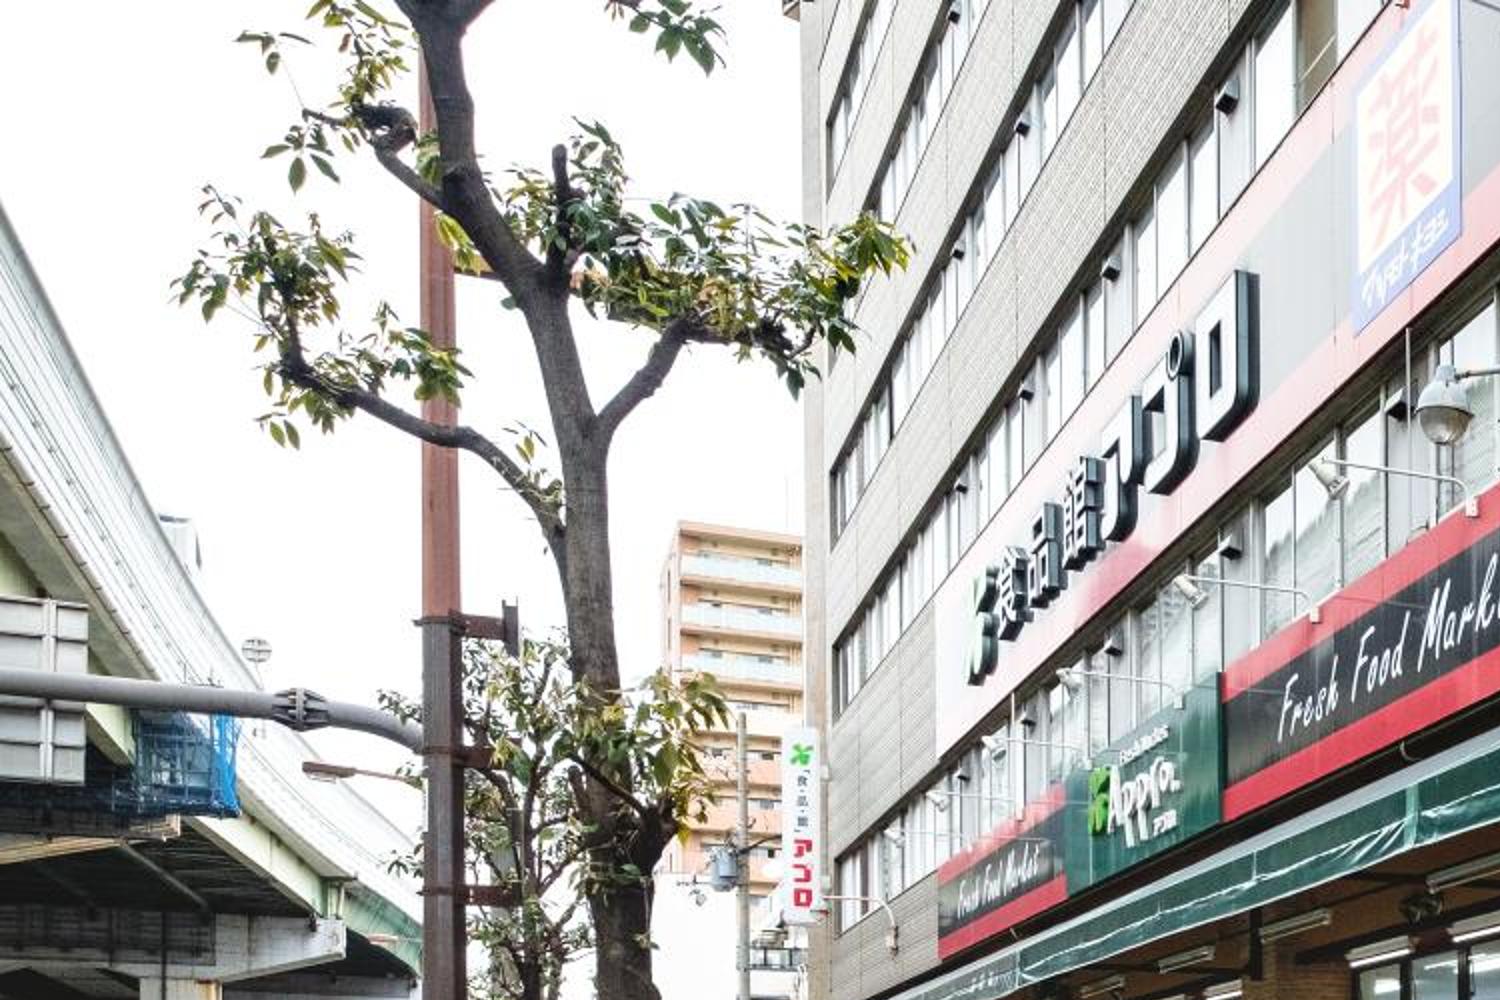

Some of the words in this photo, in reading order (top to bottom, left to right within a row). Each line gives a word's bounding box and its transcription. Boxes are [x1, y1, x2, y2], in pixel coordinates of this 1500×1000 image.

[1367, 25, 1440, 250] 薬
[1278, 655, 1339, 743] Fresh
[1350, 611, 1410, 703] Food
[957, 874, 980, 919] Fresh
[981, 859, 1003, 906] Food
[1003, 841, 1039, 896] Market
